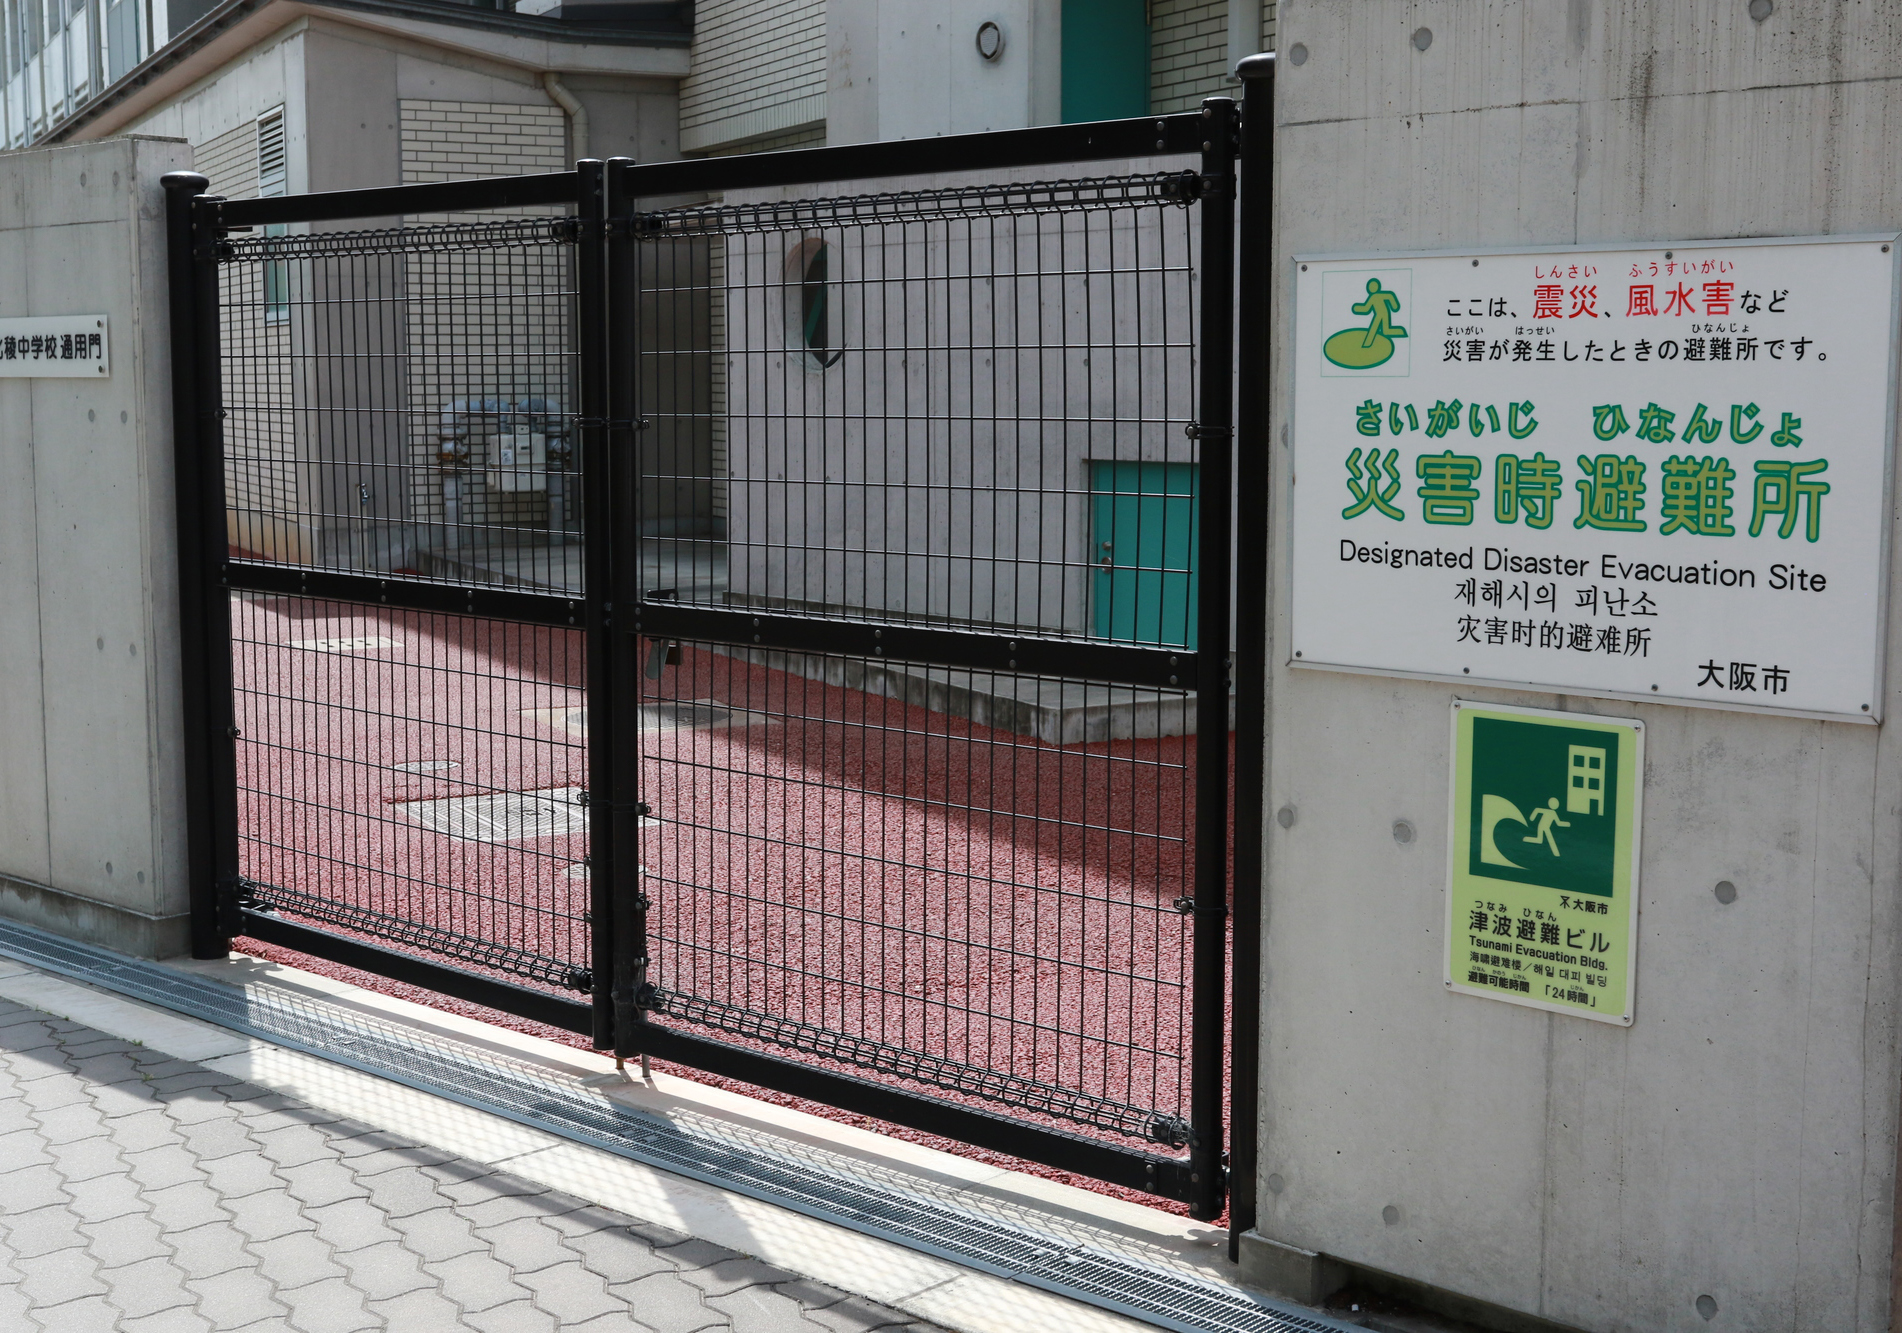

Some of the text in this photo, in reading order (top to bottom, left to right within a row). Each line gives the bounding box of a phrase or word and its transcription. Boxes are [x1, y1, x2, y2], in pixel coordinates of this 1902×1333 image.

[1535, 264, 1597, 279] しんさい
[1629, 259, 1734, 278] ふうすいがい
[1446, 326, 1484, 336] さいがい
[1515, 326, 1555, 336] はっせい
[1692, 322, 1750, 333] ひなんじょ
[0, 333, 102, 360] 稜中学校通用門
[1443, 336, 1827, 362] 災害が発生したときの避難所です。
[1356, 398, 1803, 448] さいがいじ ひなんじょ
[1342, 447, 1831, 543] 災害時避難所
[1340, 539, 1827, 592] Designated Disaster Evacuation Site
[1454, 577, 1658, 617] 재해시의 피난소
[1457, 614, 1652, 658] 灾害时的避难所
[1697, 659, 1791, 695] 大阪市
[1474, 900, 1557, 922] つなみ ひなん
[1573, 899, 1609, 915] 大阪市
[1469, 910, 1610, 953] 津波避難ビル
[1469, 935, 1608, 971] Tsunami Evacuation Bldg.
